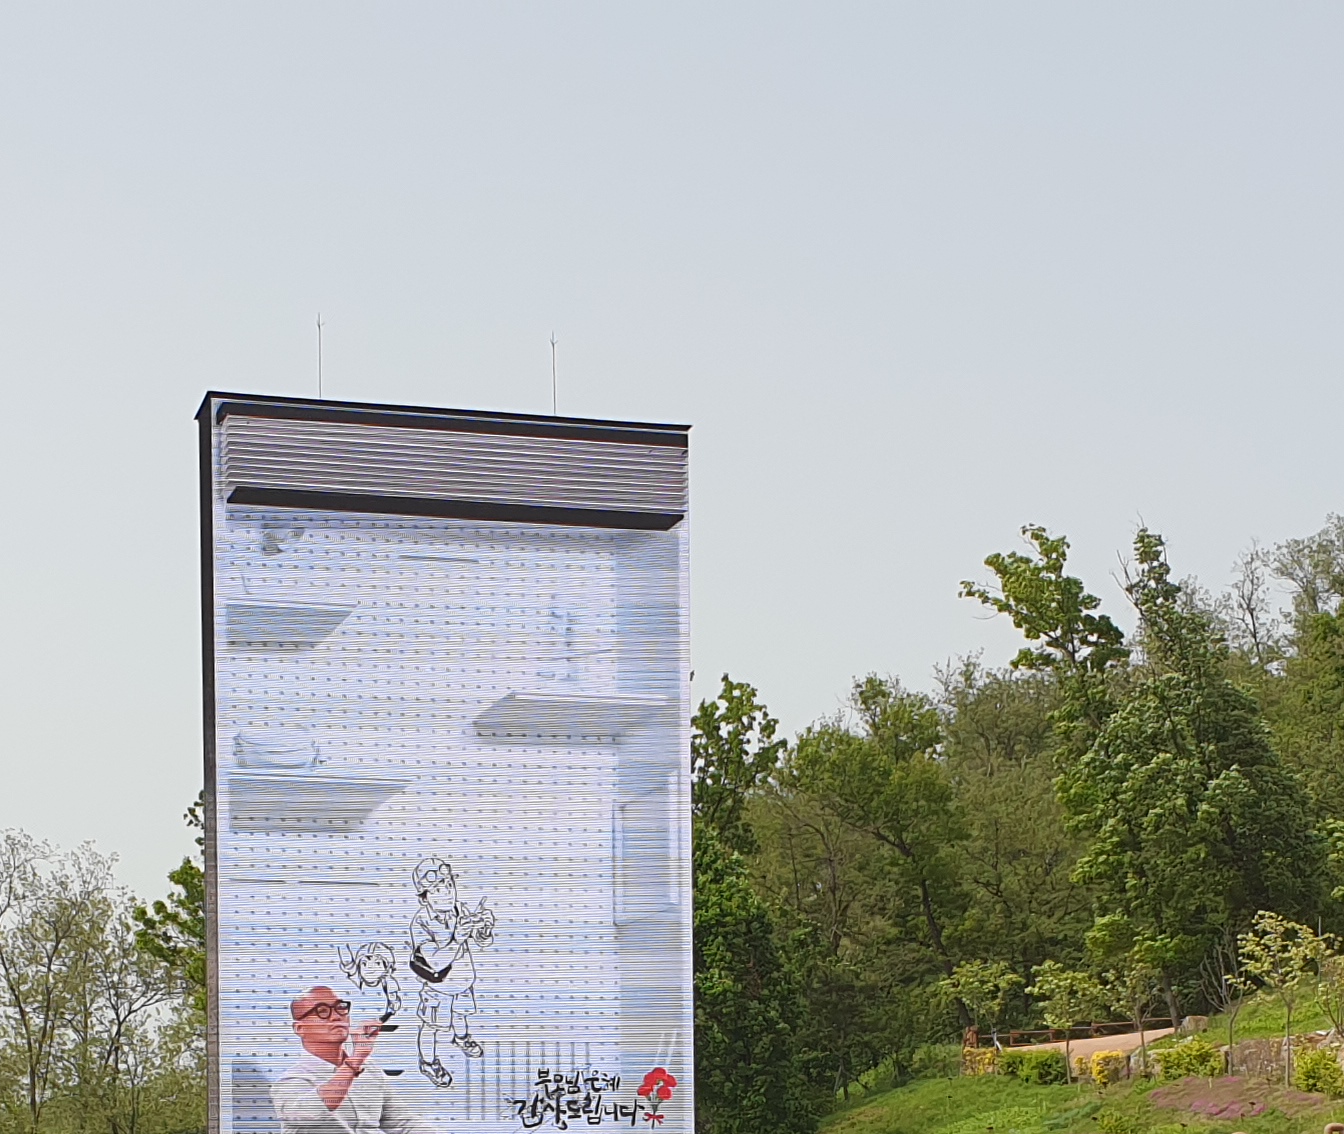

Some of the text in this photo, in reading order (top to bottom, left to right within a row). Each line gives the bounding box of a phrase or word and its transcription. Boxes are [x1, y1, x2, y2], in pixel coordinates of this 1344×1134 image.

[535, 1068, 621, 1098] 부모님 은혜
[513, 1094, 645, 1130] 감사드립니다
